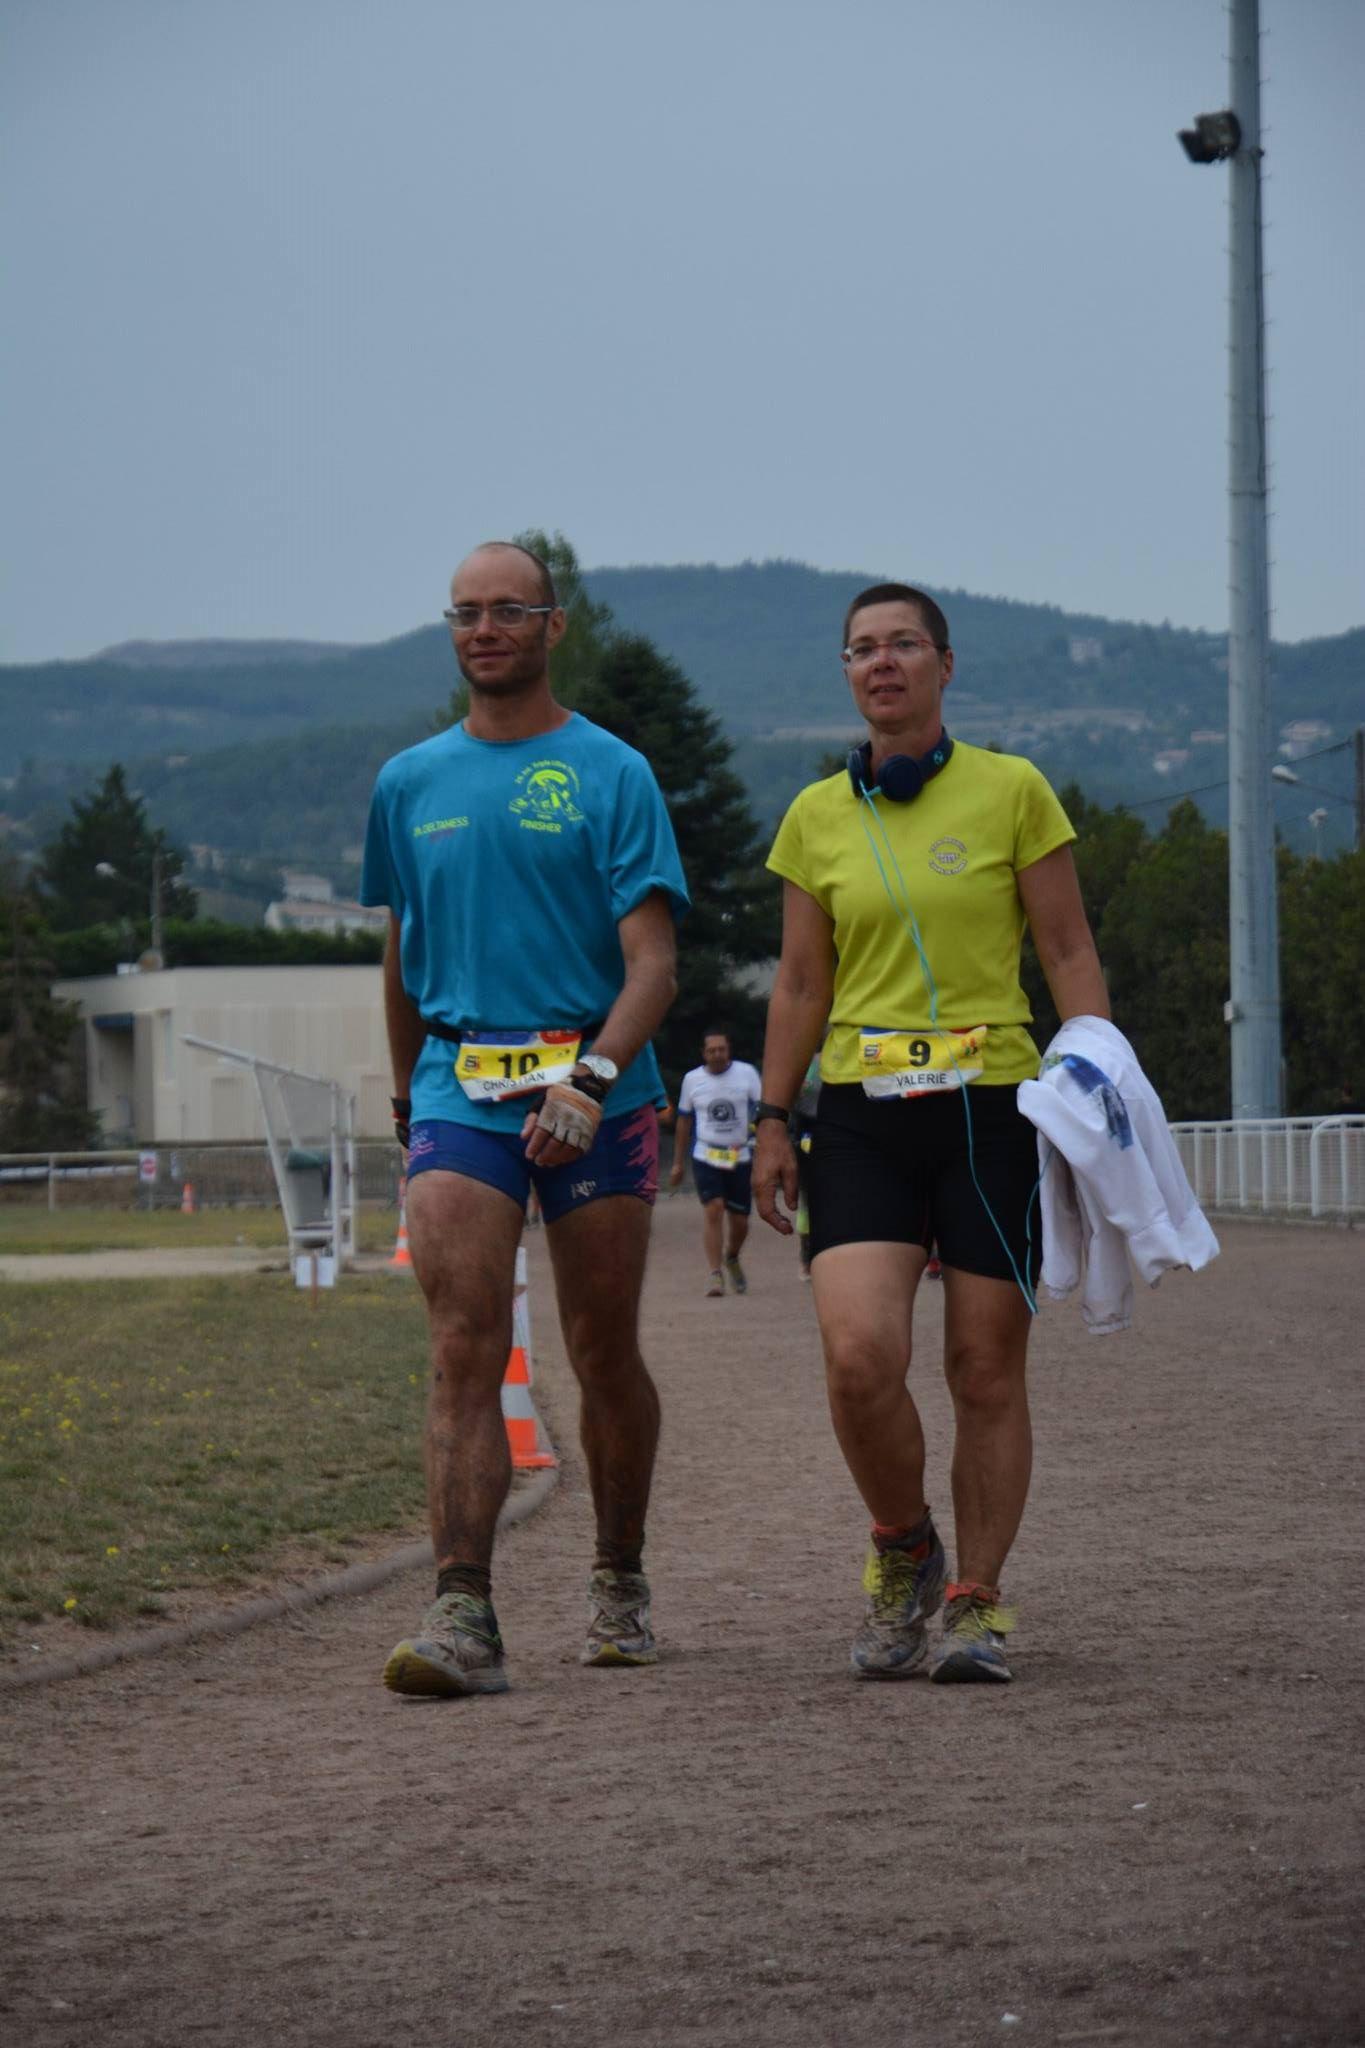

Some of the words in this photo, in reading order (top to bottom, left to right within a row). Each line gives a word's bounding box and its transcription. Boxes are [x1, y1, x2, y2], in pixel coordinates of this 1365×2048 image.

[520, 819, 561, 833] FINISHER
[909, 1040, 931, 1067] 9
[498, 1053, 540, 1079] 10
[896, 1073, 947, 1087] VALERIE
